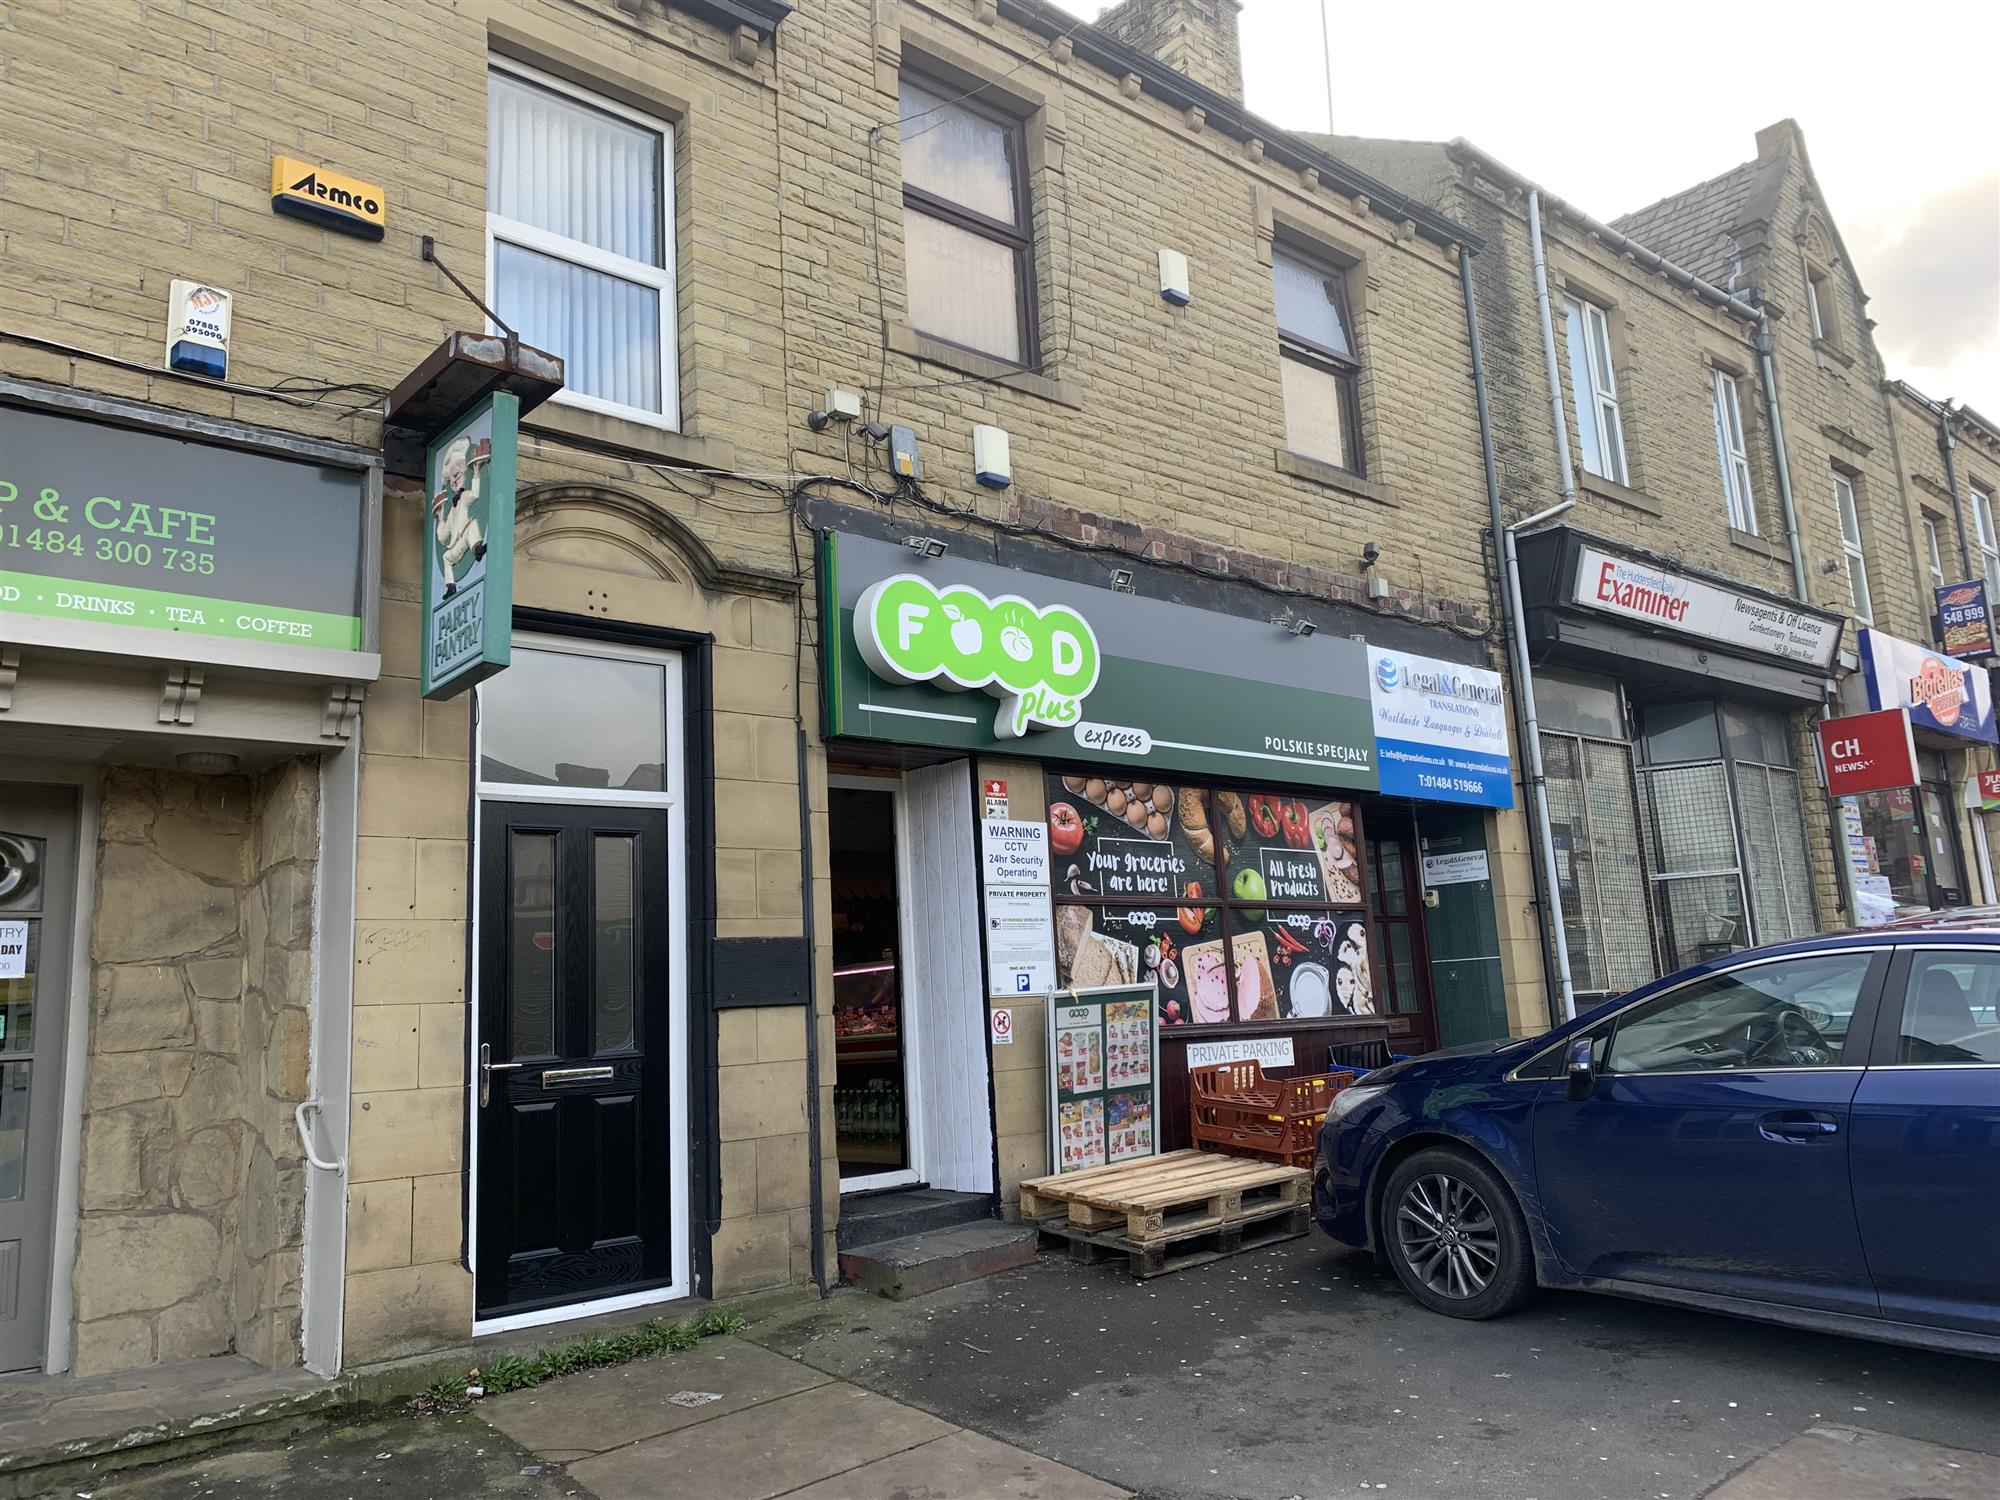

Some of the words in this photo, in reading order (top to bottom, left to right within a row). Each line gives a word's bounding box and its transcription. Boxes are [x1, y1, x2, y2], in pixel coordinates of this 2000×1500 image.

[186, 326, 222, 339] 595090
[189, 319, 219, 331] 07885
[33, 488, 69, 523] &
[84, 497, 216, 545] CAFE
[0, 524, 85, 557] 1484
[95, 538, 151, 566] 300
[162, 547, 215, 575] 735
[1597, 561, 1690, 622] Examiner
[56, 592, 135, 616] DRINKS
[166, 607, 206, 625] TEA
[236, 616, 312, 638] COFFEE
[438, 592, 480, 640] PARTY
[1778, 611, 1785, 625] &
[1786, 614, 1799, 628] Off
[1797, 617, 1822, 636] Licence
[1944, 611, 1963, 625] 548
[1965, 606, 1985, 621] 999
[1749, 621, 1787, 641] Confectionery
[435, 617, 482, 667] PANTRY
[1402, 665, 1502, 704] Legal&General
[1429, 699, 1480, 717] TRANSLATIONS
[1379, 707, 1420, 727] Worldwide
[1424, 715, 1463, 736] Languages
[1473, 723, 1504, 741] Dialects
[1084, 727, 1142, 751] express
[1265, 736, 1315, 756] POLSKIE
[1316, 743, 1368, 763] SPECJAŁY
[1454, 779, 1484, 794] 519666
[989, 826, 1041, 839] WARNING
[1004, 842, 1028, 851] CCTV
[989, 854, 1008, 864] 24hr
[1010, 855, 1044, 867] Security
[1087, 851, 1121, 872] Your
[1124, 852, 1186, 874] groceries
[1270, 859, 1284, 877] All
[1287, 861, 1316, 879] fresh
[997, 867, 1038, 879] Operating
[1110, 875, 1133, 891] are
[1137, 874, 1168, 892] here!
[1192, 1045, 1240, 1062] PRIVATE
[1243, 1041, 1290, 1058] PARKING
